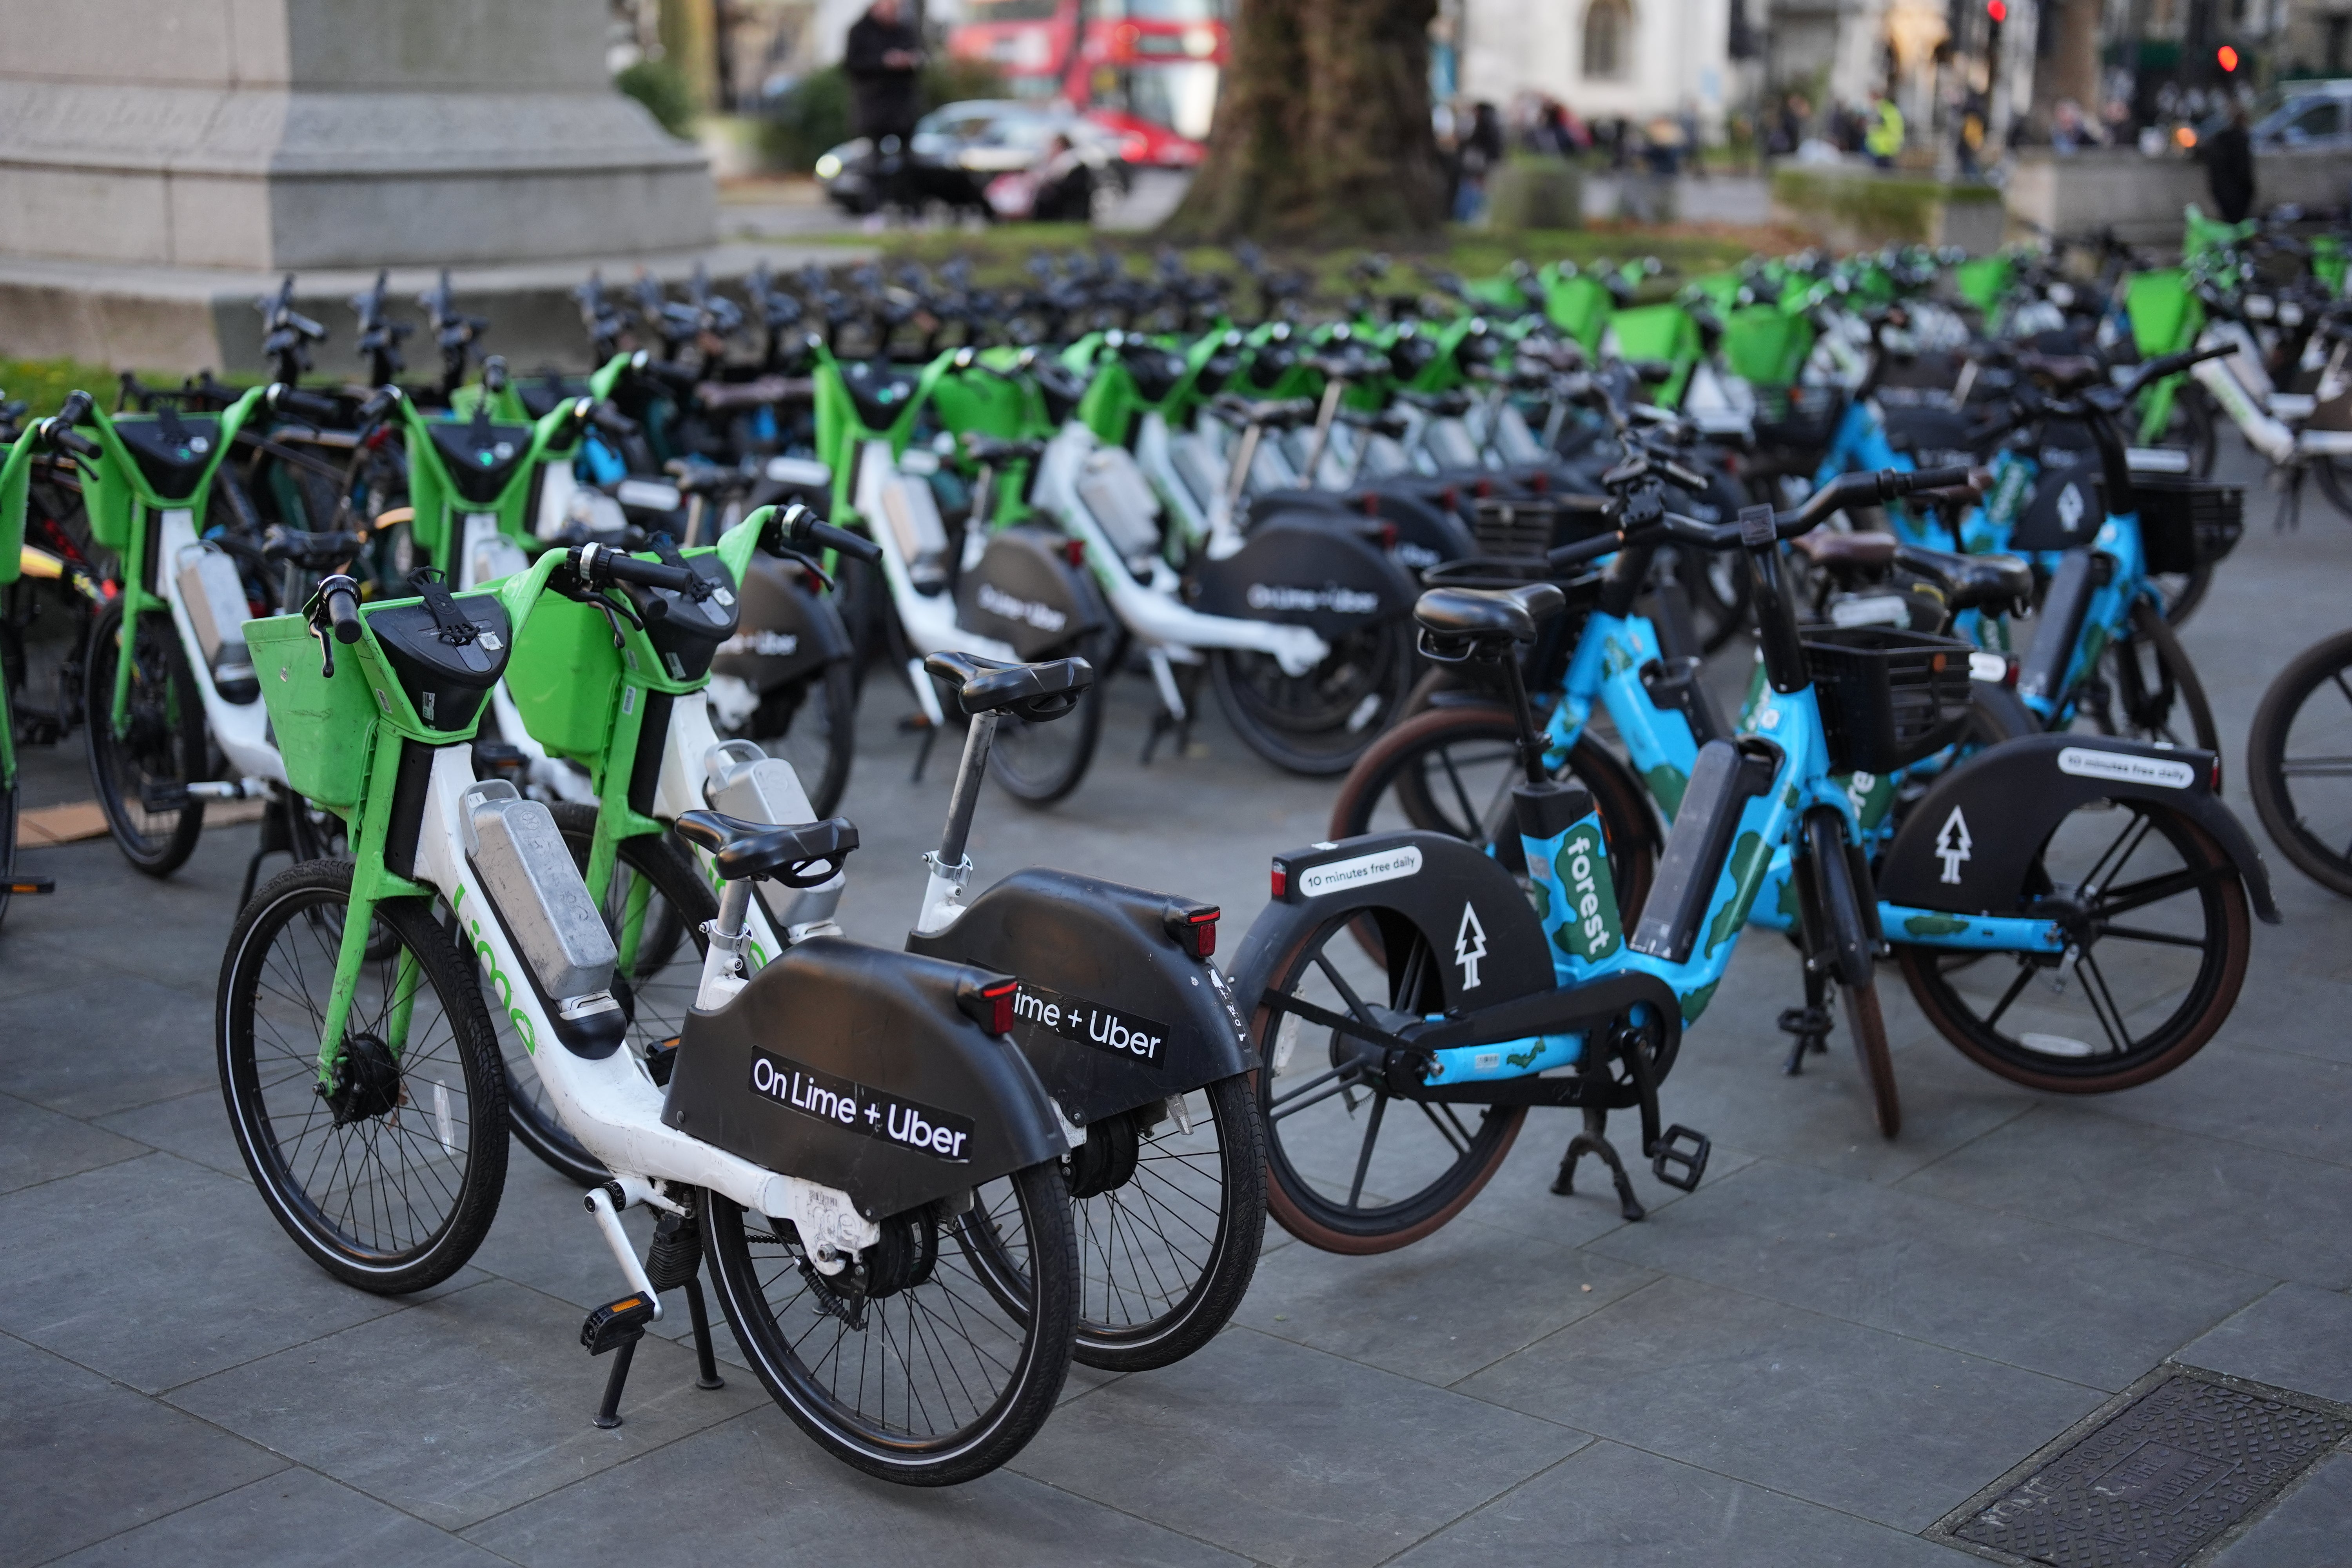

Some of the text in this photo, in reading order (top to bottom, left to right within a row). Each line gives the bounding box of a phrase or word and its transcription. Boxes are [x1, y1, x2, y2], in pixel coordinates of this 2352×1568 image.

[1308, 855, 1415, 887] 10 minutes free daily
[1567, 836, 1610, 955] forest
[1012, 985, 1060, 1026] ime
[1089, 1010, 1161, 1058] Uber
[754, 1058, 787, 1099] On
[791, 1072, 857, 1123] Lime
[888, 1103, 966, 1156] Uber
[2222, 1439, 2318, 1505] BRIGHOUSE
